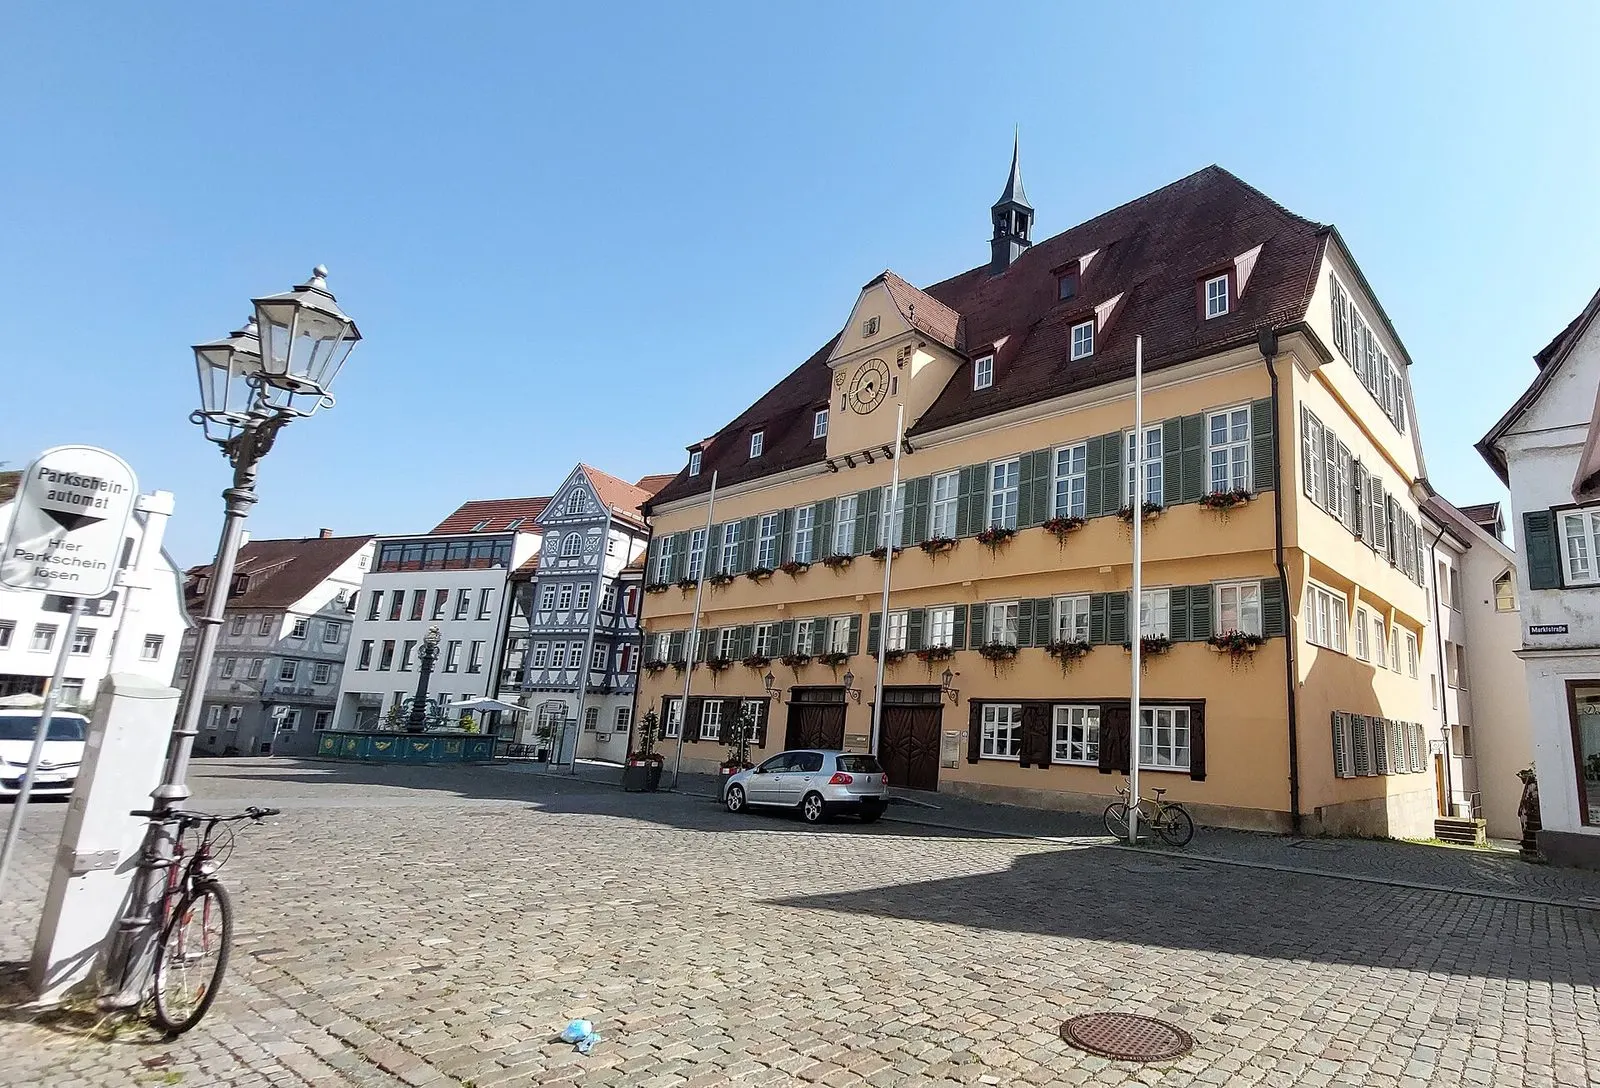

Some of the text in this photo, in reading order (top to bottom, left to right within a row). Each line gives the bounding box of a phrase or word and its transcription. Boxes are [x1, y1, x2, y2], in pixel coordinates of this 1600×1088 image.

[38, 467, 128, 494] Parkschein-
[48, 490, 109, 509] automat
[48, 538, 83, 552] Hier
[13, 548, 107, 570] Parkschein
[34, 567, 80, 581] lösen
[1531, 625, 1566, 633] Marktstraße
